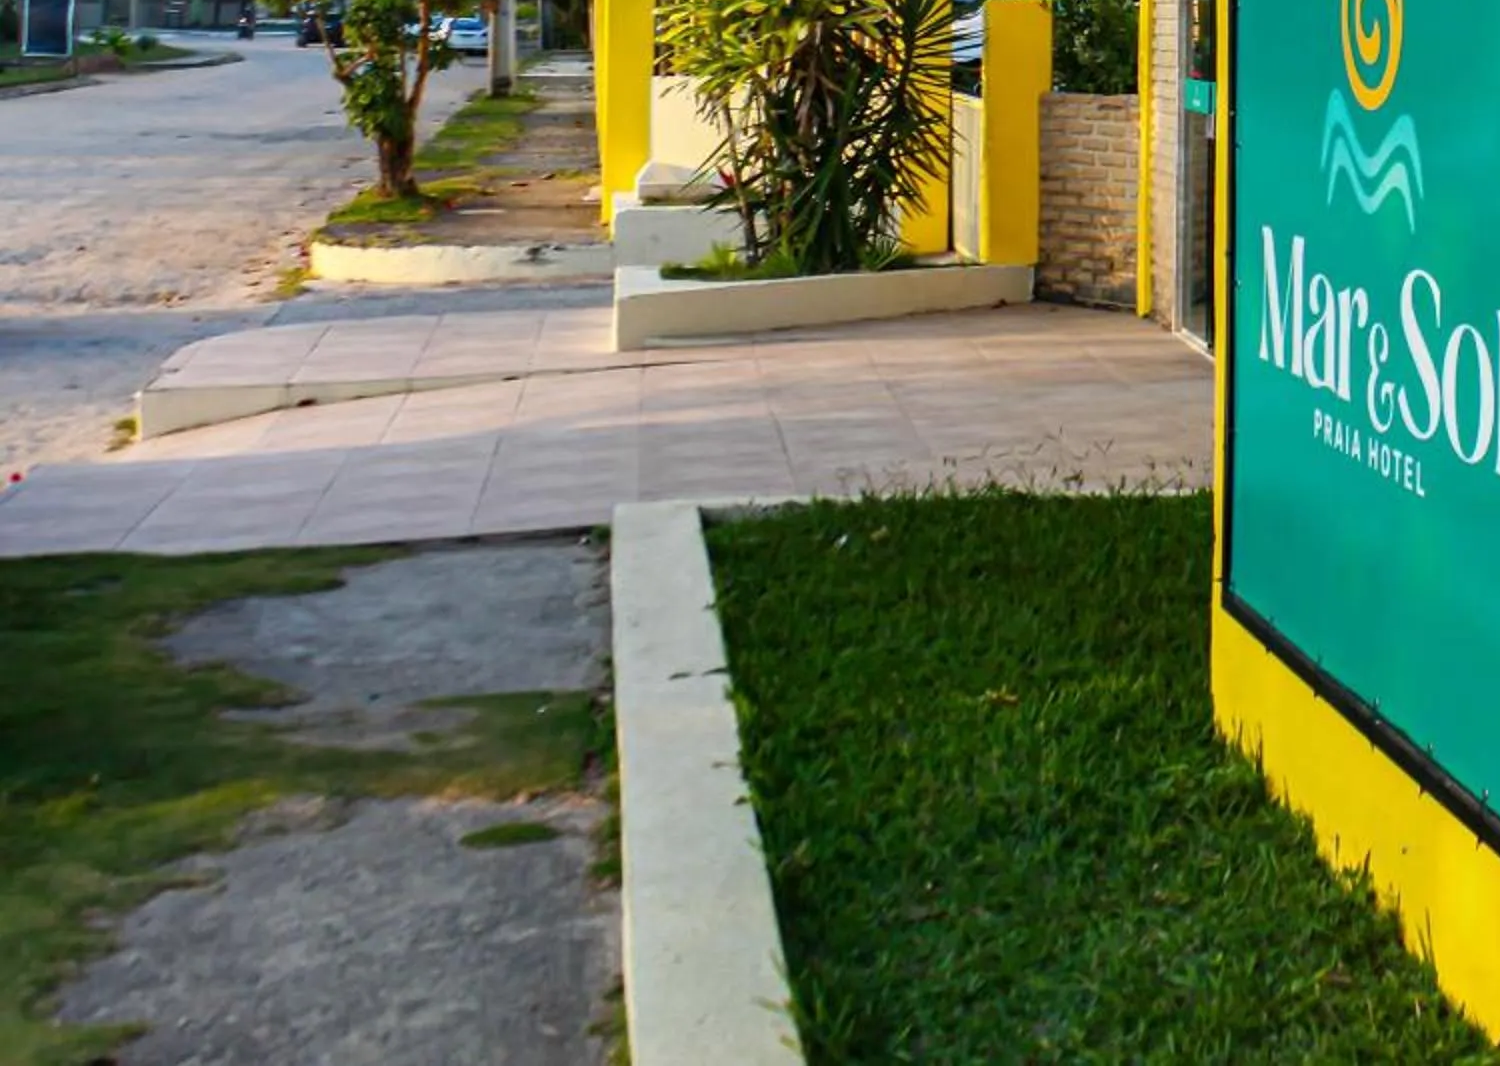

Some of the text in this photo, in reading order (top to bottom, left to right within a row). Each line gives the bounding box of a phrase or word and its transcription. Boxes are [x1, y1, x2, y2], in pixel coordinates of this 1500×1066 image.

[1259, 225, 1369, 401] Mar
[1367, 323, 1395, 433] &
[1313, 408, 1425, 497] PRAIA HOTEL
